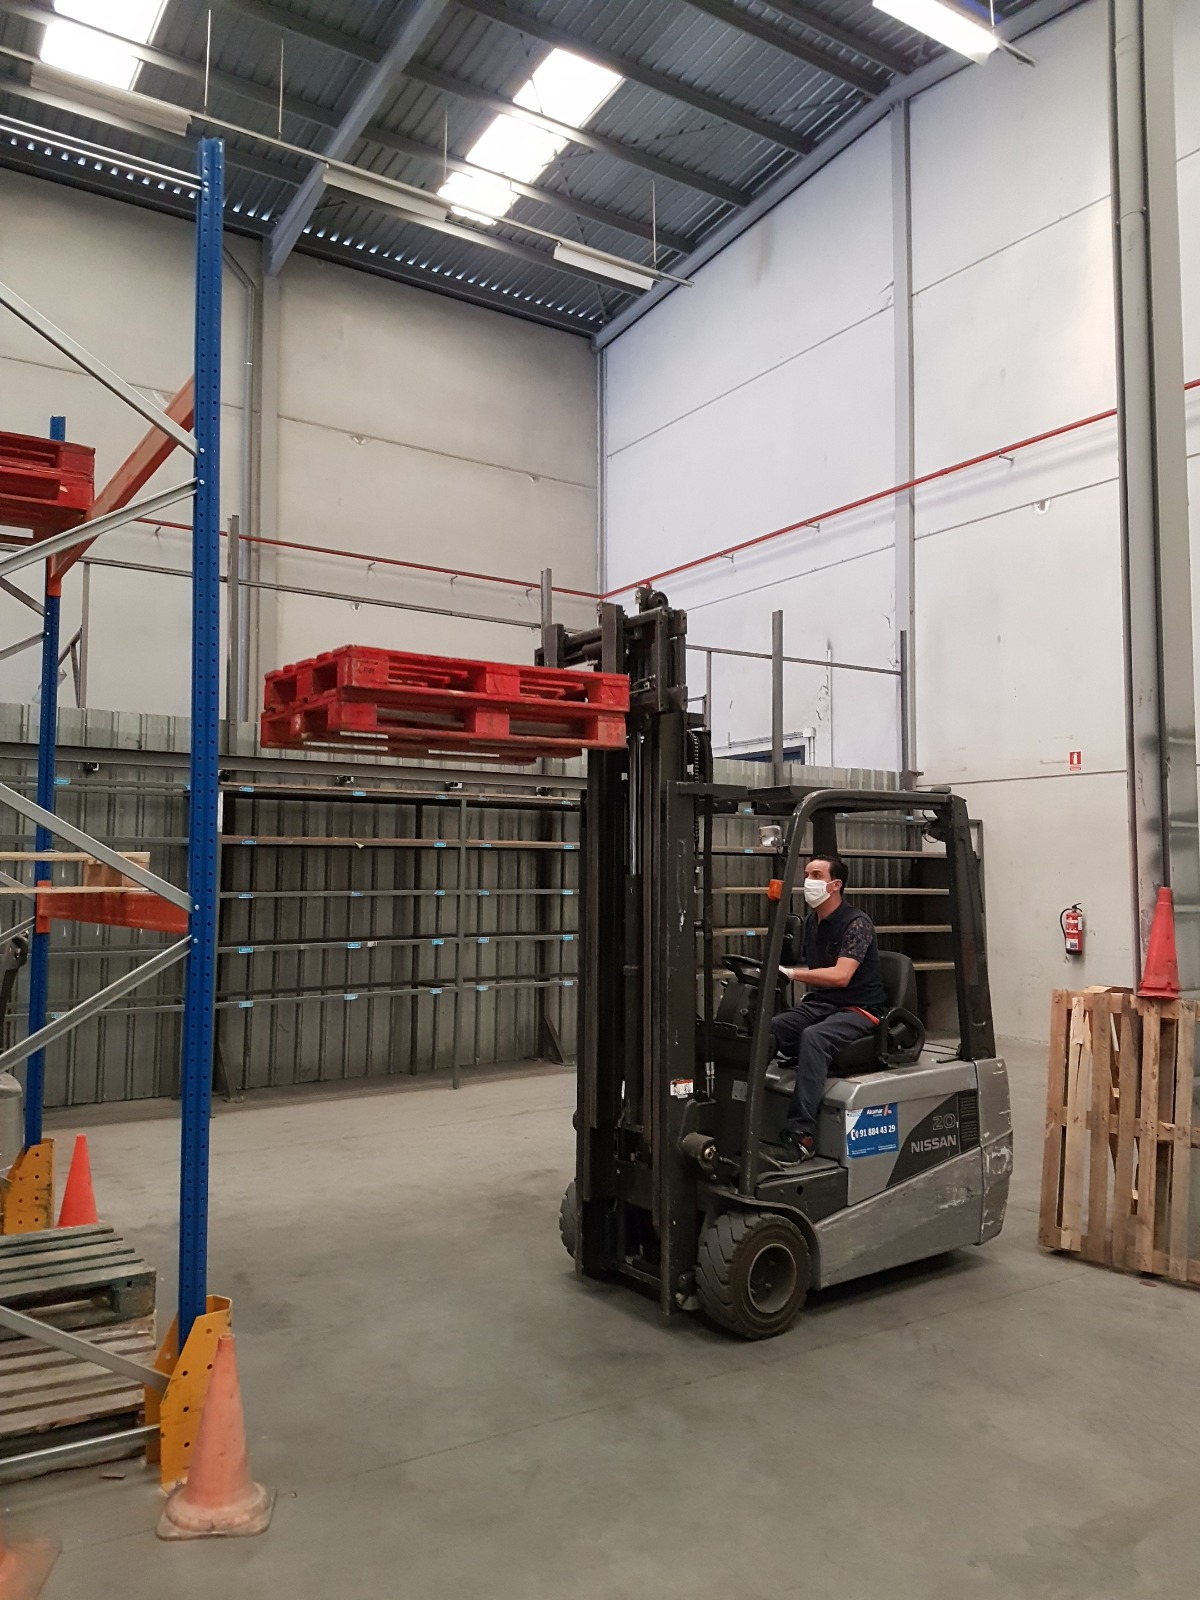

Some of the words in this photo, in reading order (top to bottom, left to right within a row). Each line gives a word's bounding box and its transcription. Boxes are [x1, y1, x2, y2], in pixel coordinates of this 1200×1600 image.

[932, 1114, 956, 1130] 20
[859, 1129, 867, 1138] 91
[868, 1127, 879, 1136] 884
[880, 1126, 888, 1134] 43
[888, 1124, 896, 1133] 29
[911, 1134, 957, 1154] NISSAN
